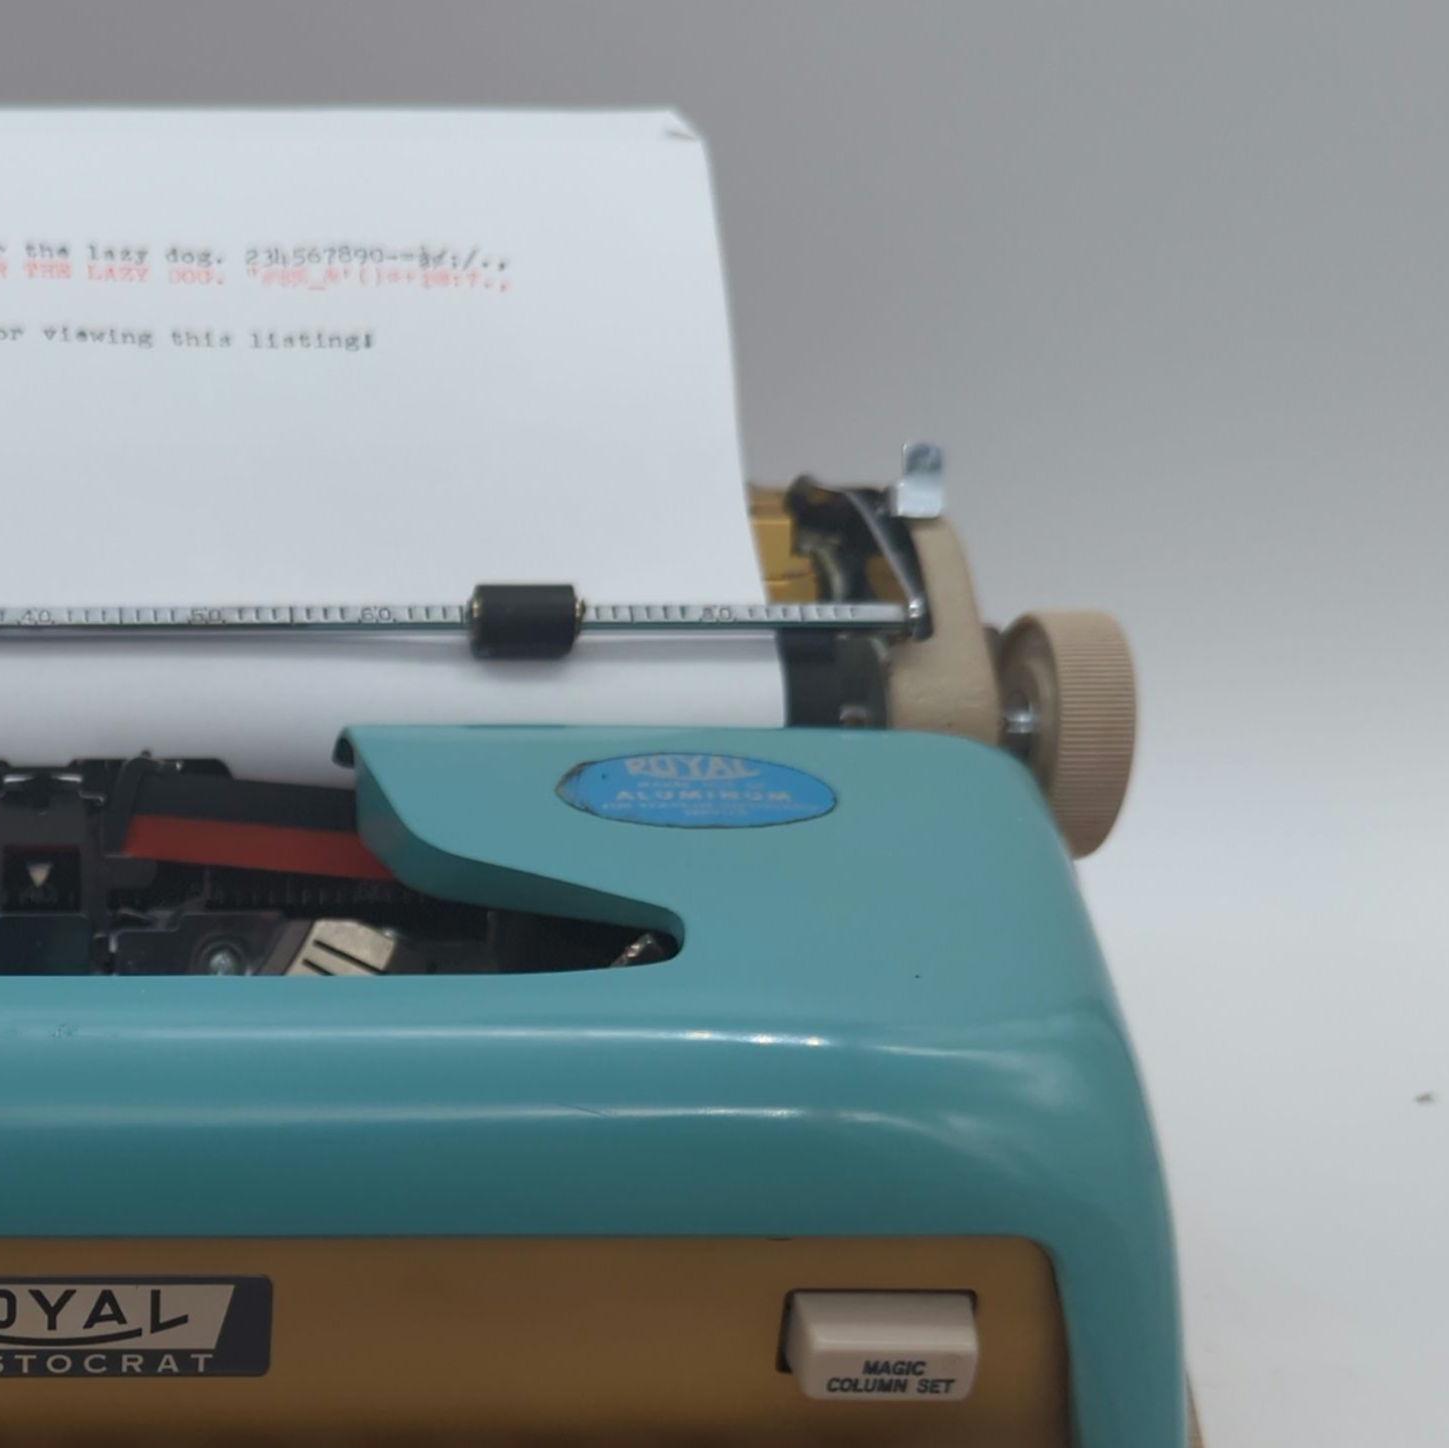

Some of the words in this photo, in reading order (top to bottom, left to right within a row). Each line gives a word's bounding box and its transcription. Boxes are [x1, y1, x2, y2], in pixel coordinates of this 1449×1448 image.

[25, 244, 70, 260] the
[87, 245, 148, 265] lazy
[166, 248, 224, 267] dog.
[43, 326, 154, 348] viewing
[171, 329, 233, 348] this
[21, 608, 51, 623] 40
[191, 608, 222, 623] 50
[361, 607, 392, 622] 60
[625, 755, 761, 780] ROYAL
[863, 1361, 926, 1376] MAGIC
[827, 1378, 908, 1393] COLUMN
[917, 1379, 955, 1394] SET
